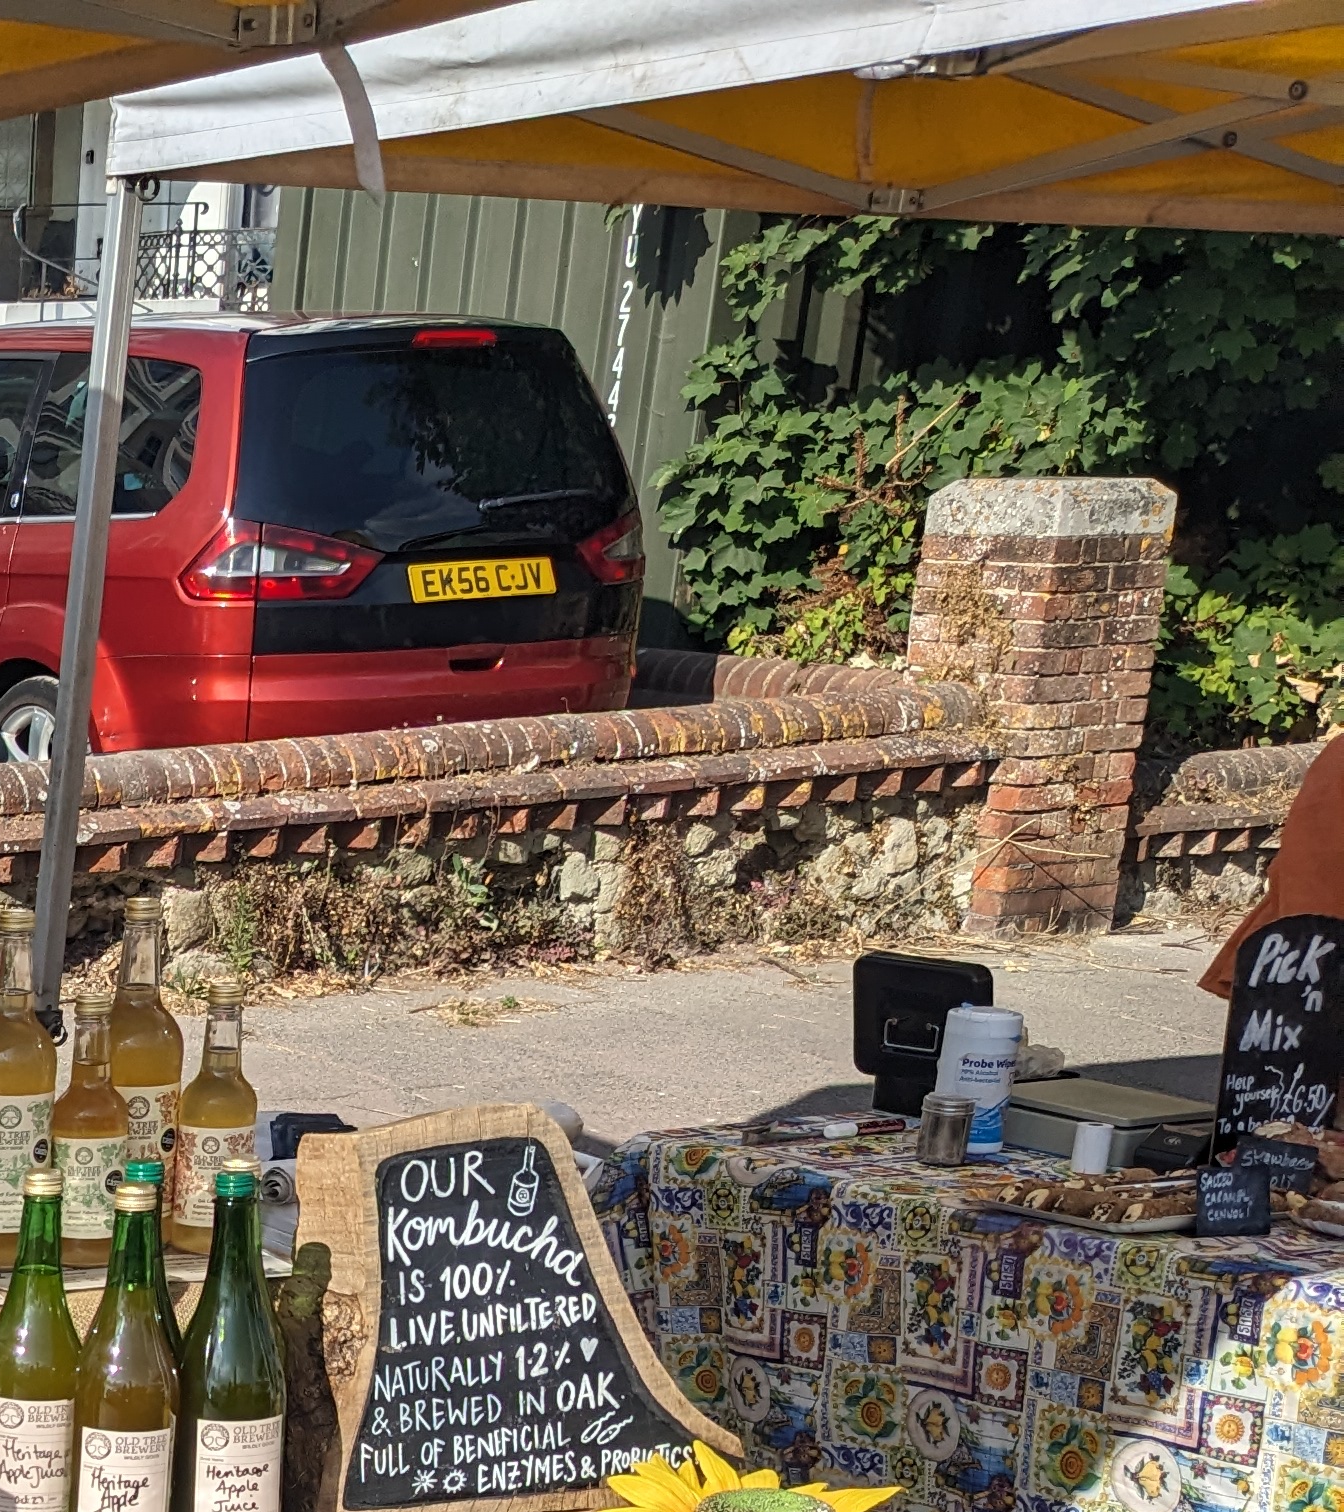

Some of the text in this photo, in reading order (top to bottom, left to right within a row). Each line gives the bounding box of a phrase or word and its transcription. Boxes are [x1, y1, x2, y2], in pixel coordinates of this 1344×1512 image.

[421, 562, 541, 598] EK56 CJV
[1239, 1009, 1303, 1051] Mix
[962, 1059, 994, 1069] Probe
[1226, 1074, 1254, 1091] Help
[1218, 1118, 1232, 1134] To
[1237, 1121, 1245, 1131] a
[401, 1150, 496, 1203] OUR
[388, 1200, 584, 1286] Kombucha
[399, 1260, 516, 1306] IS 100%
[374, 1351, 503, 1402] NATURALLY
[372, 1407, 392, 1437] &
[400, 1394, 502, 1433] BREWED
[519, 1386, 545, 1415] IN
[115, 1434, 168, 1446] OLD TREE
[233, 1421, 280, 1435] OLD TREE
[233, 1430, 280, 1443] BREWERY
[2, 1438, 62, 1469] Heritage
[115, 1444, 166, 1454] BREWERY
[361, 1421, 572, 1483] FULL OF BENEFICIAL
[206, 1464, 269, 1480] Heritage
[580, 1455, 597, 1479] &
[91, 1466, 149, 1500] Heritage
[215, 1480, 260, 1499] Apple
